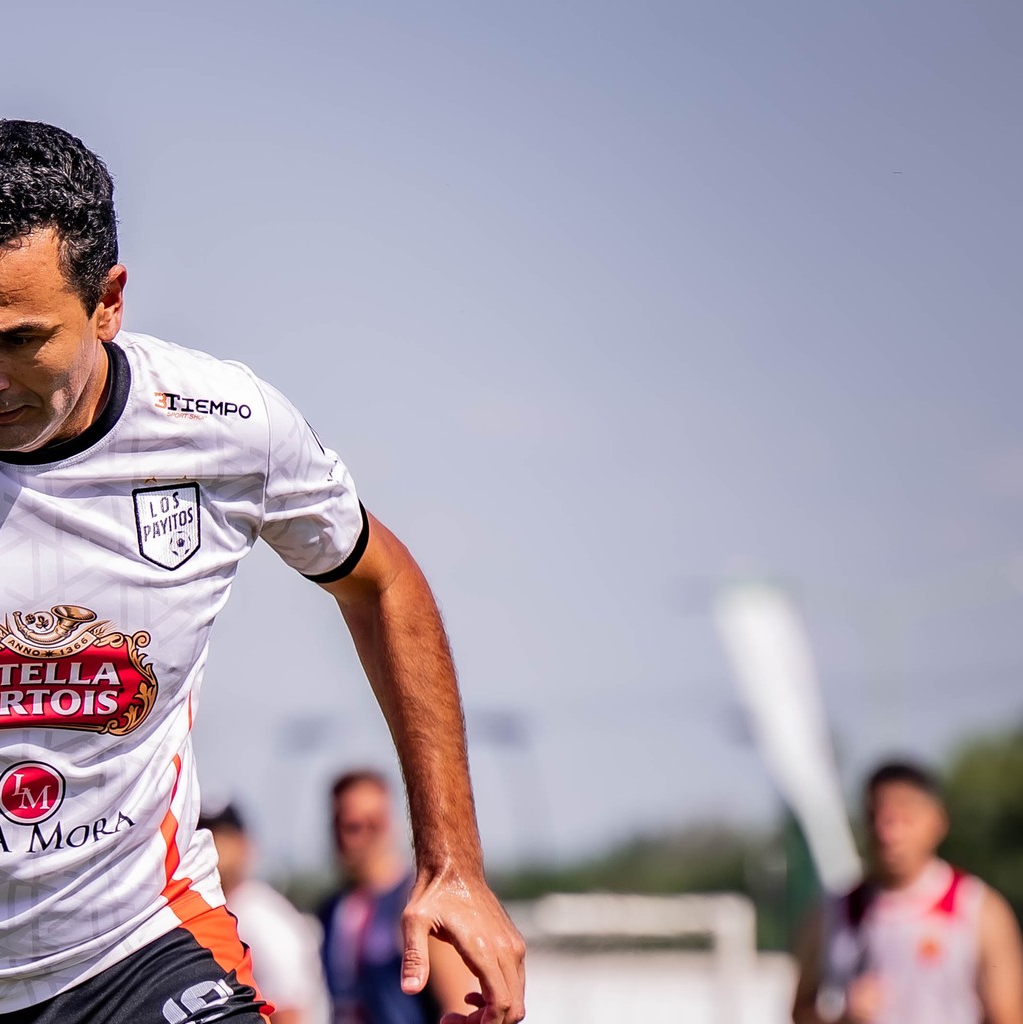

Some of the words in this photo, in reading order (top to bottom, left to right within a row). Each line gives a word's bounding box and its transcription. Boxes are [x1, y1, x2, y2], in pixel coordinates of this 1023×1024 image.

[154, 392, 252, 419] 3TIEMPO
[167, 412, 187, 420] SPORT
[149, 491, 180, 519] LOS
[143, 506, 194, 542] PAYITOS
[8, 639, 41, 657] ANNO
[59, 637, 88, 656] 1366
[27, 810, 136, 853] MORA
